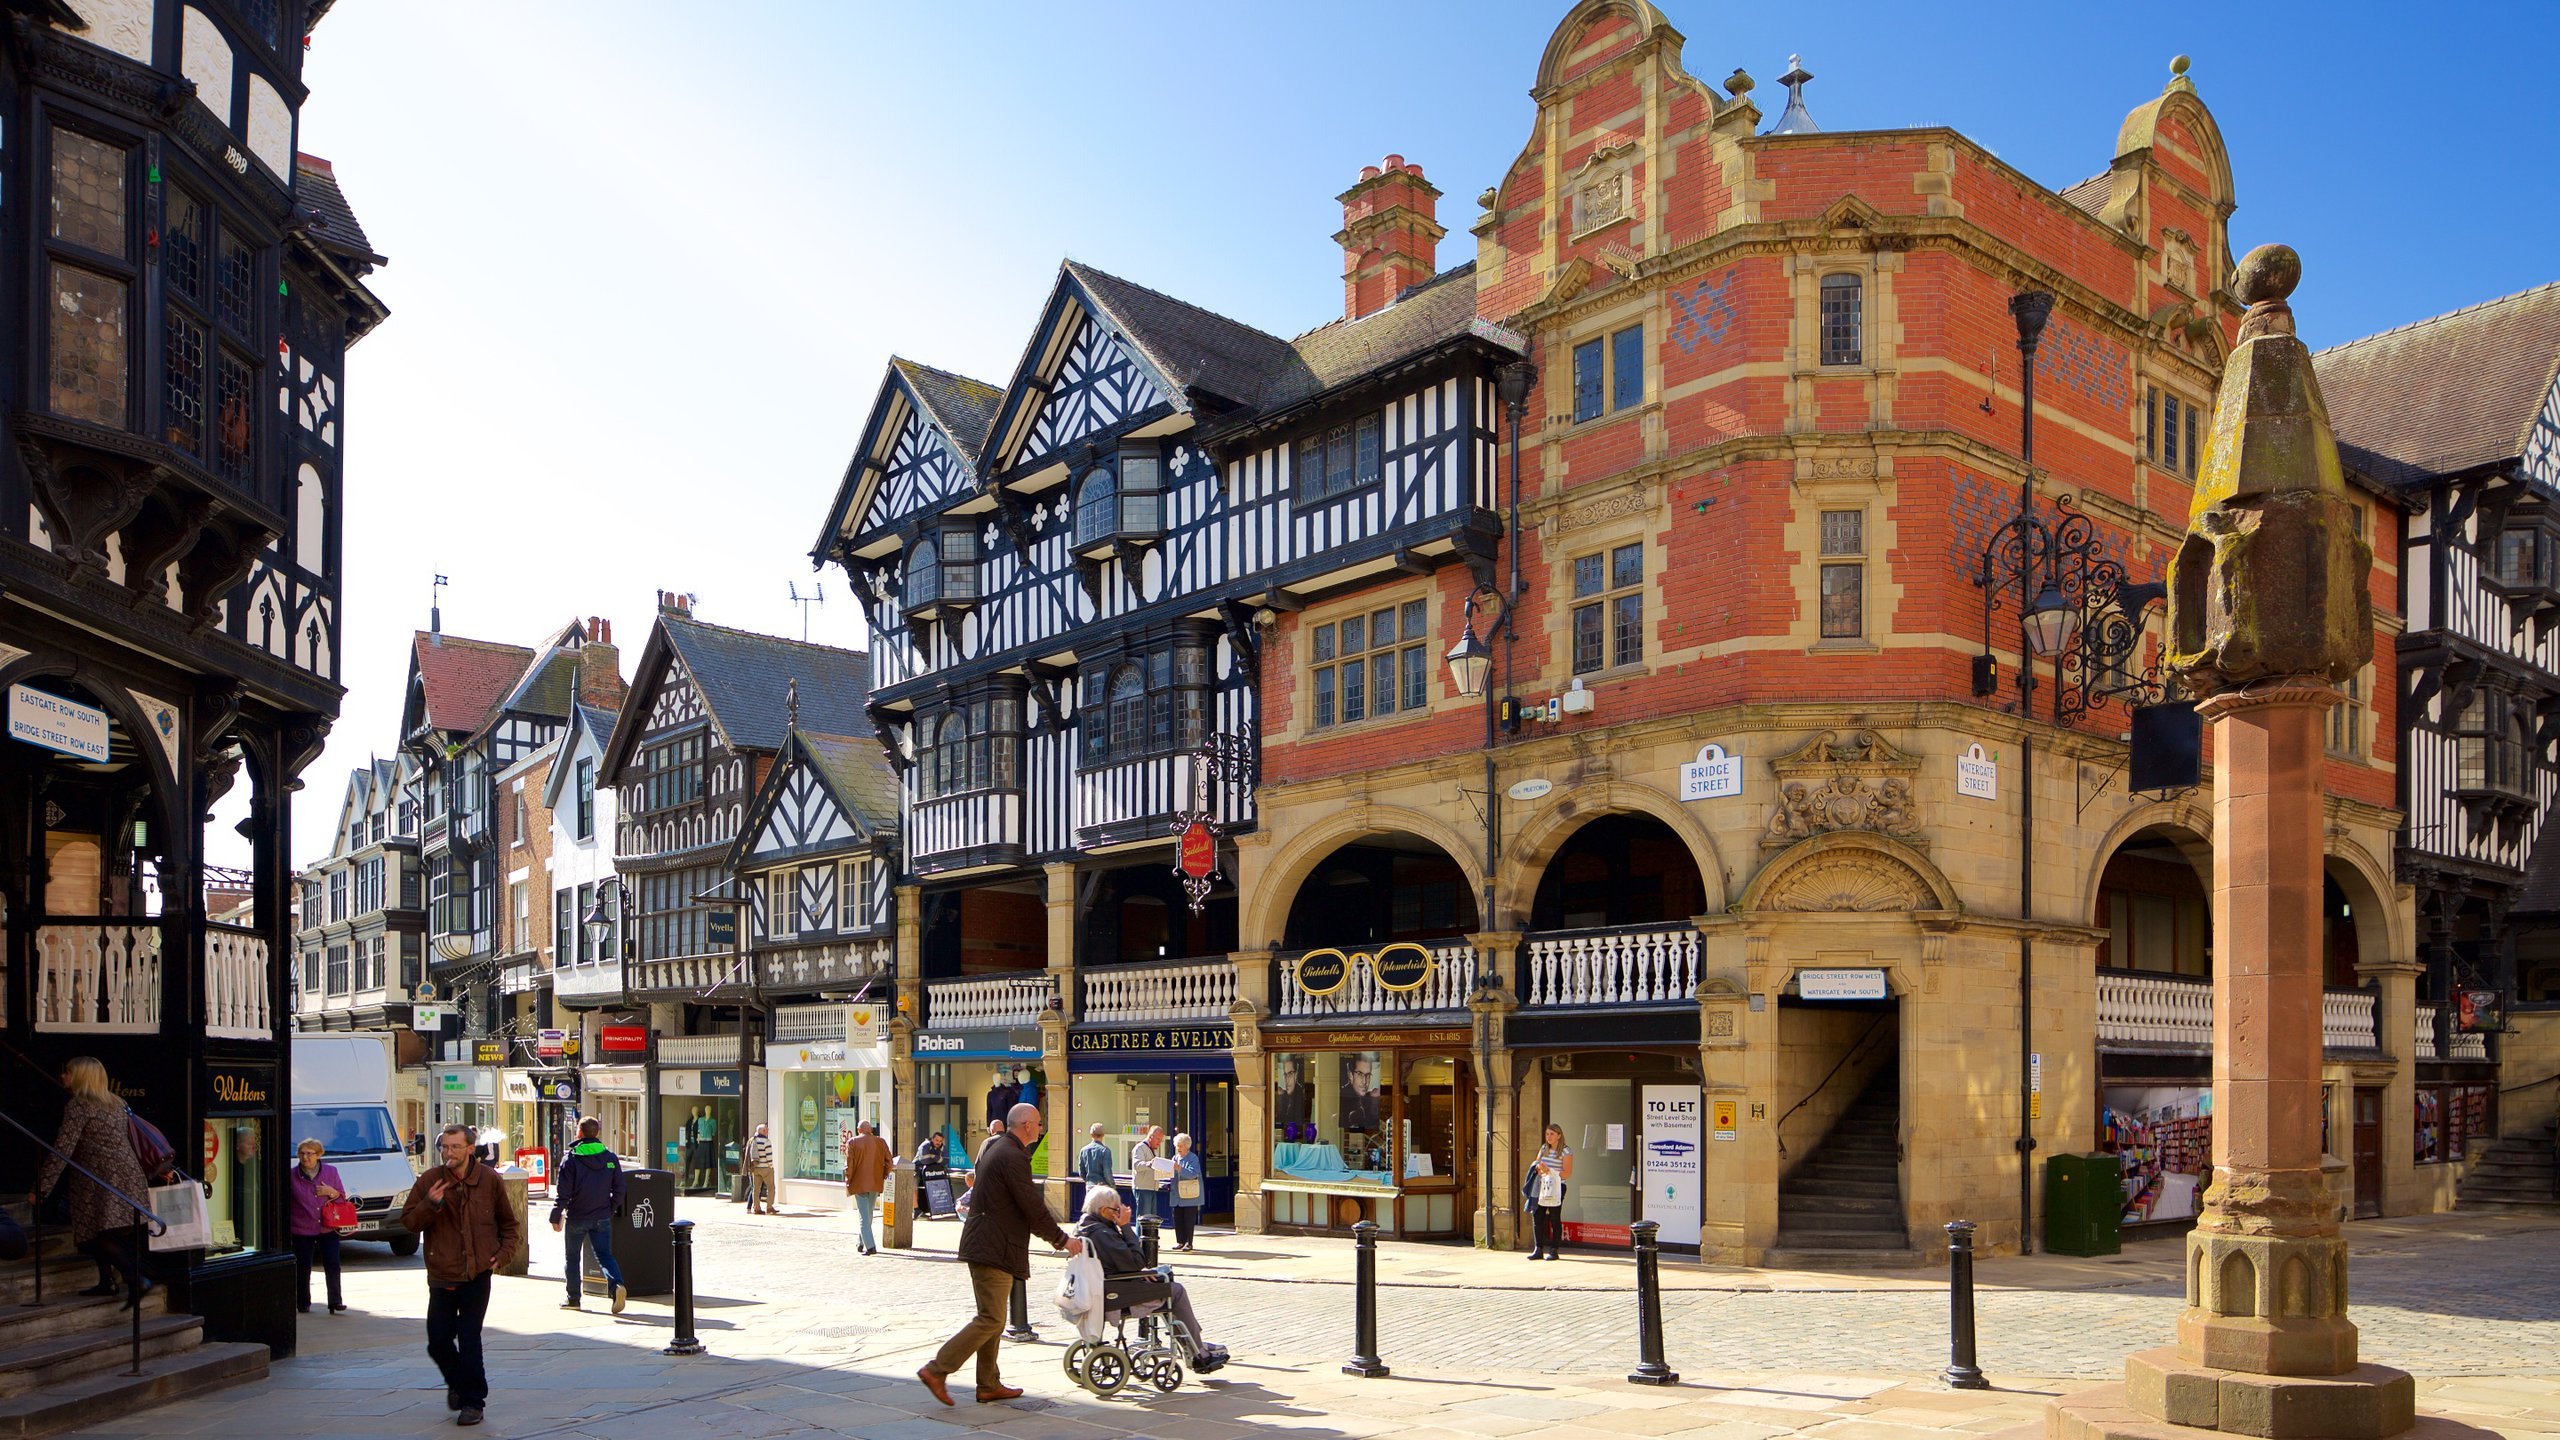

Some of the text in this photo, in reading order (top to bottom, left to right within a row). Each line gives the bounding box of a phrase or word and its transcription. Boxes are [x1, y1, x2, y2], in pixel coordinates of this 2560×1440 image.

[224, 145, 248, 174] 1888
[20, 692, 100, 726] EASTGATE ROW SOUTH
[14, 721, 105, 756] BRIDGE STREET ROW EAST
[1691, 763, 1729, 779] BRIDGE
[1960, 761, 1995, 779] WATERGATE
[1690, 778, 1729, 793] STREET
[1964, 777, 1989, 792] STREET
[1183, 839, 1209, 858] Siddall
[710, 922, 734, 933] Viyella
[1302, 964, 1340, 979] Siddalls
[918, 1034, 965, 1051] Rohan
[1071, 1031, 1235, 1050] CRABTREE & EVELYN
[1368, 1032, 1401, 1043] Opticians
[1446, 1032, 1461, 1041] 1815
[810, 1050, 845, 1061] Thomas Cook
[1009, 1044, 1037, 1052] Rohan
[478, 1053, 504, 1061] NEWS
[213, 1075, 266, 1102] Waltons
[713, 1076, 730, 1090] Viyella
[1648, 1102, 1695, 1112] TO LET
[950, 1156, 966, 1166] NEW
[1670, 1161, 1696, 1169] 351212
